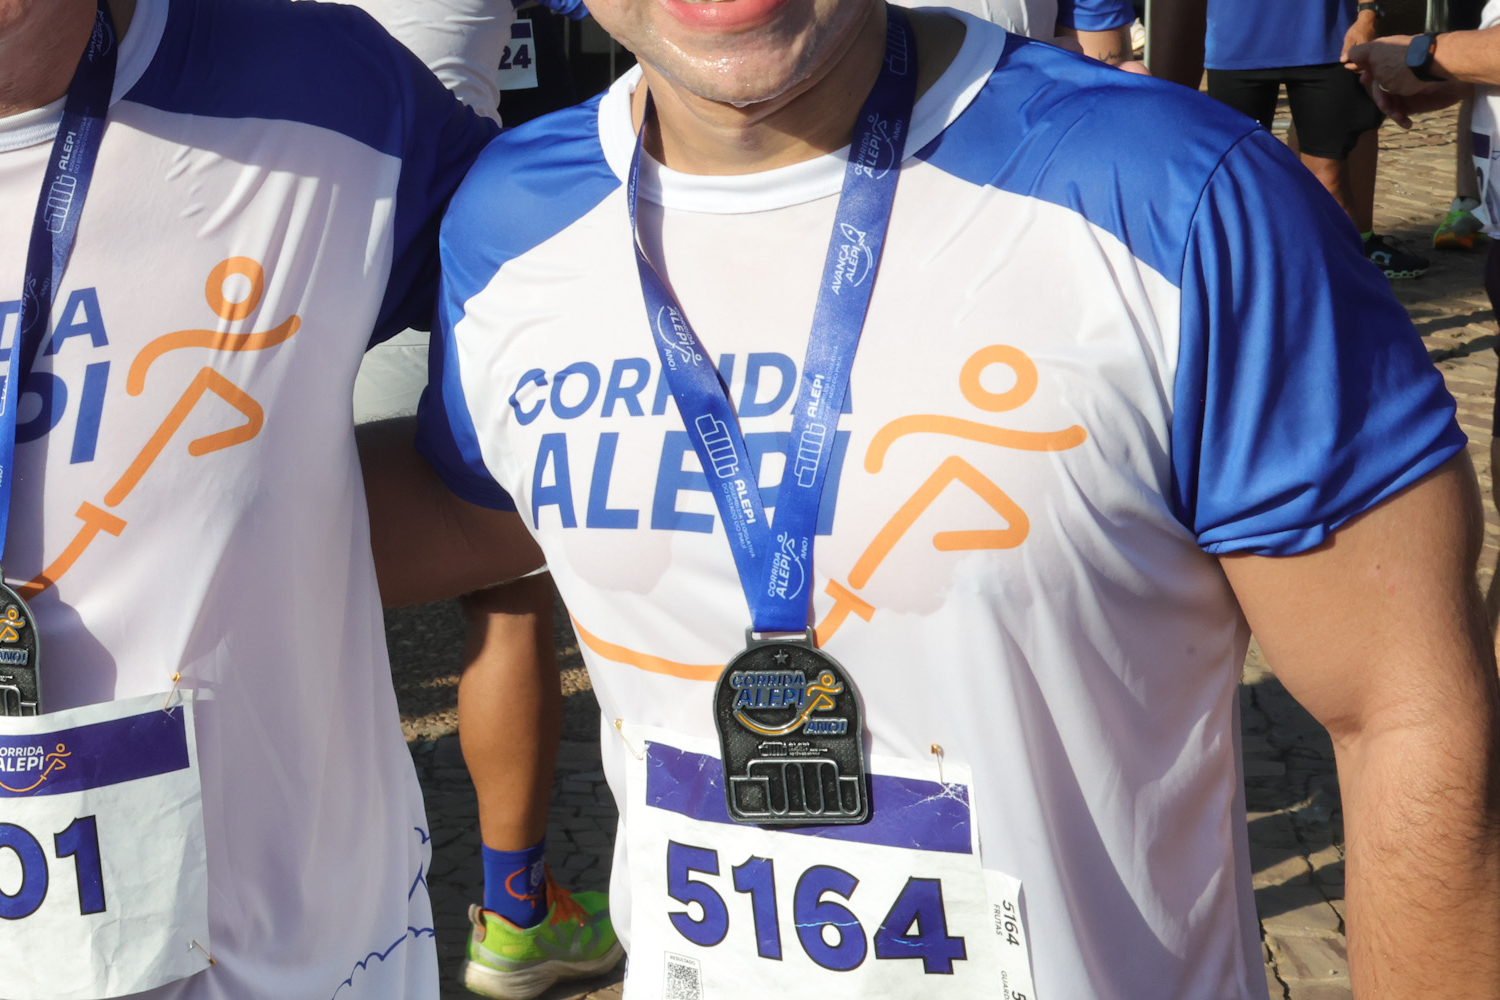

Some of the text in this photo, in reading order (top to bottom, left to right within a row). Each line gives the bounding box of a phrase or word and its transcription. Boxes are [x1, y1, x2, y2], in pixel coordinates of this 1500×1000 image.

[58, 130, 77, 171] ALEPI
[854, 131, 871, 176] CORRIDA
[863, 134, 883, 179] ALEPI
[831, 244, 851, 296] AVANÇA
[845, 245, 861, 283] ALEPI
[666, 305, 690, 346] ALEPI
[508, 352, 854, 426] CORID
[806, 373, 826, 418] ALEPI
[733, 479, 757, 524] ALEPI
[767, 551, 782, 598] CORRIDA
[775, 556, 793, 600] ALEPI
[731, 674, 805, 687] CORRIDA
[735, 687, 805, 708] ALEPI
[666, 838, 969, 975] 5164
[993, 903, 1003, 937] FRUTAS
[1002, 899, 1020, 948] 5164
